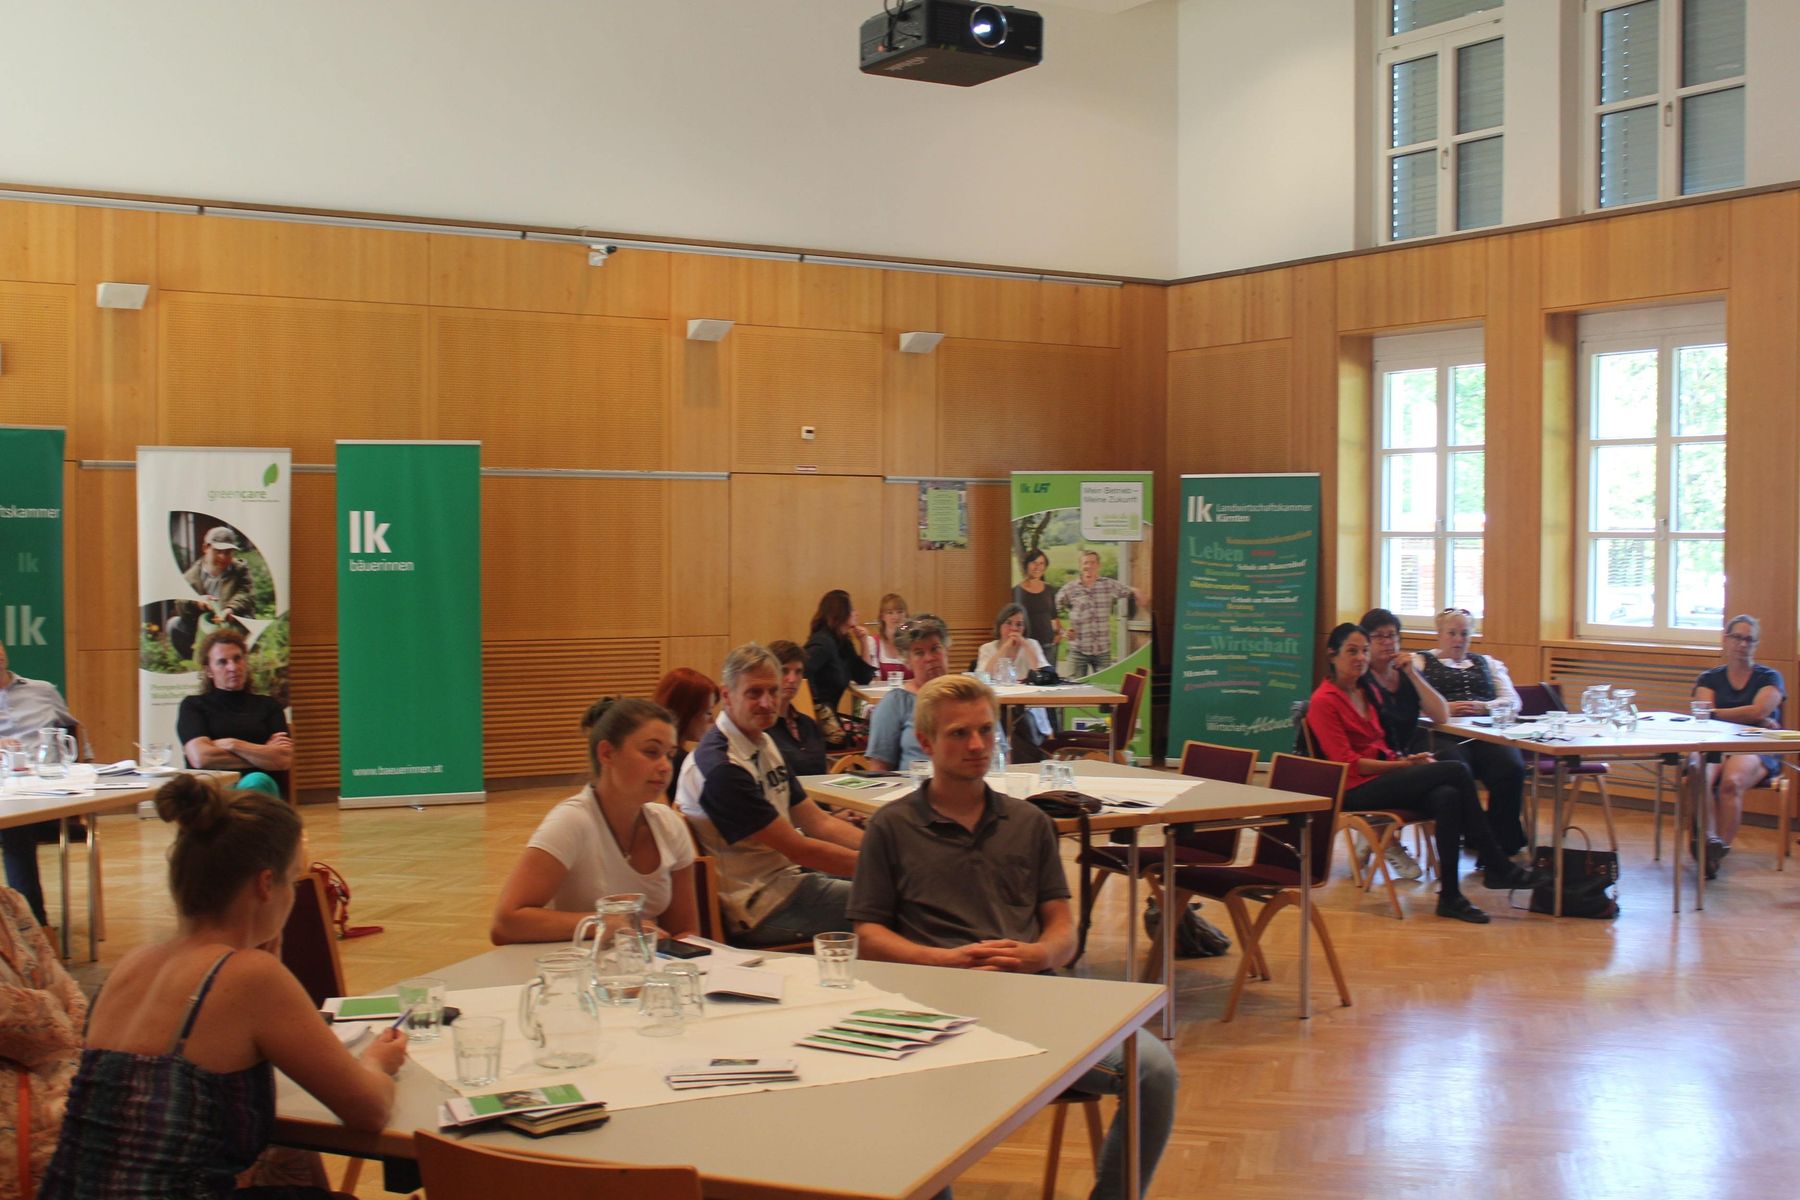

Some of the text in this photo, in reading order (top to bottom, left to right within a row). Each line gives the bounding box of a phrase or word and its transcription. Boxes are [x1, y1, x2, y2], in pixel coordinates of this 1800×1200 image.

[1187, 496, 1213, 522] lk
[349, 510, 392, 553] lk
[1188, 536, 1244, 561] Leben
[349, 559, 415, 572] bäuerinnen
[5, 605, 47, 646] lk
[1210, 636, 1299, 654] Wirtschaft
[352, 764, 444, 776] www.baeuerinnen.at
